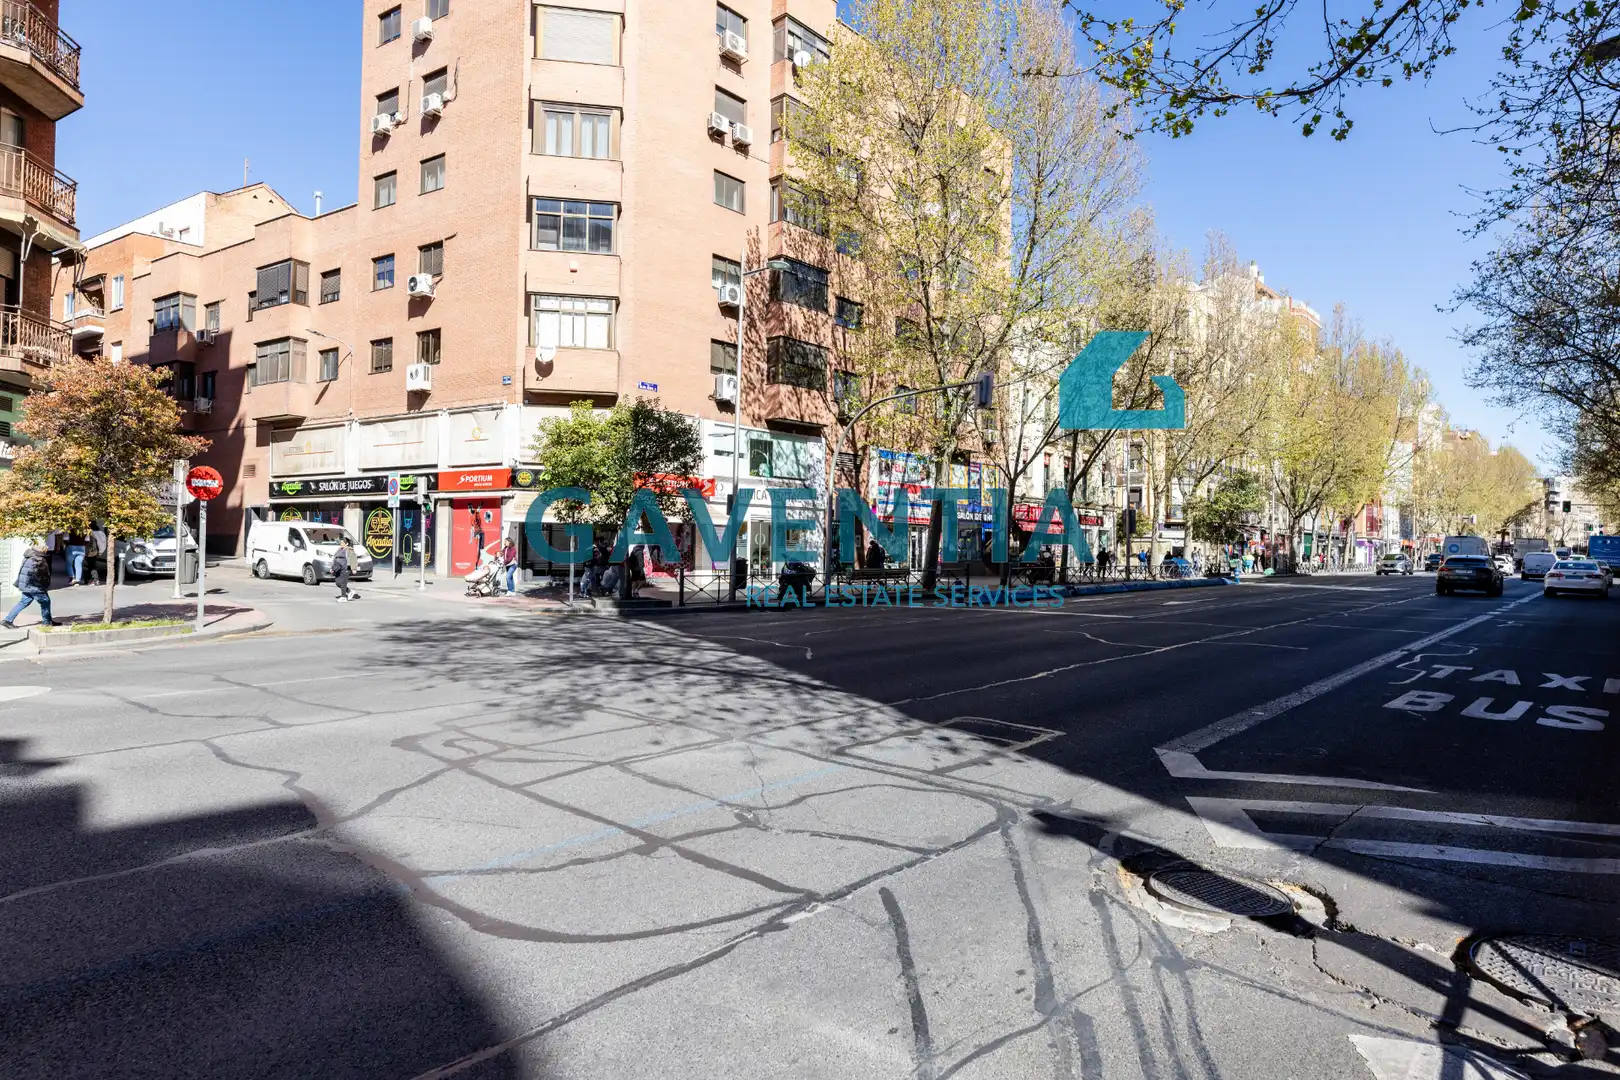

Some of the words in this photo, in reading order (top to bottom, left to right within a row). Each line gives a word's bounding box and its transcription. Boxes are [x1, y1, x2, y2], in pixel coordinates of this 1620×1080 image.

[457, 474, 492, 484] SPORTIUM
[318, 481, 339, 491] SALÓN
[347, 480, 372, 491] JUEGOS
[1382, 689, 1609, 731] BUS
